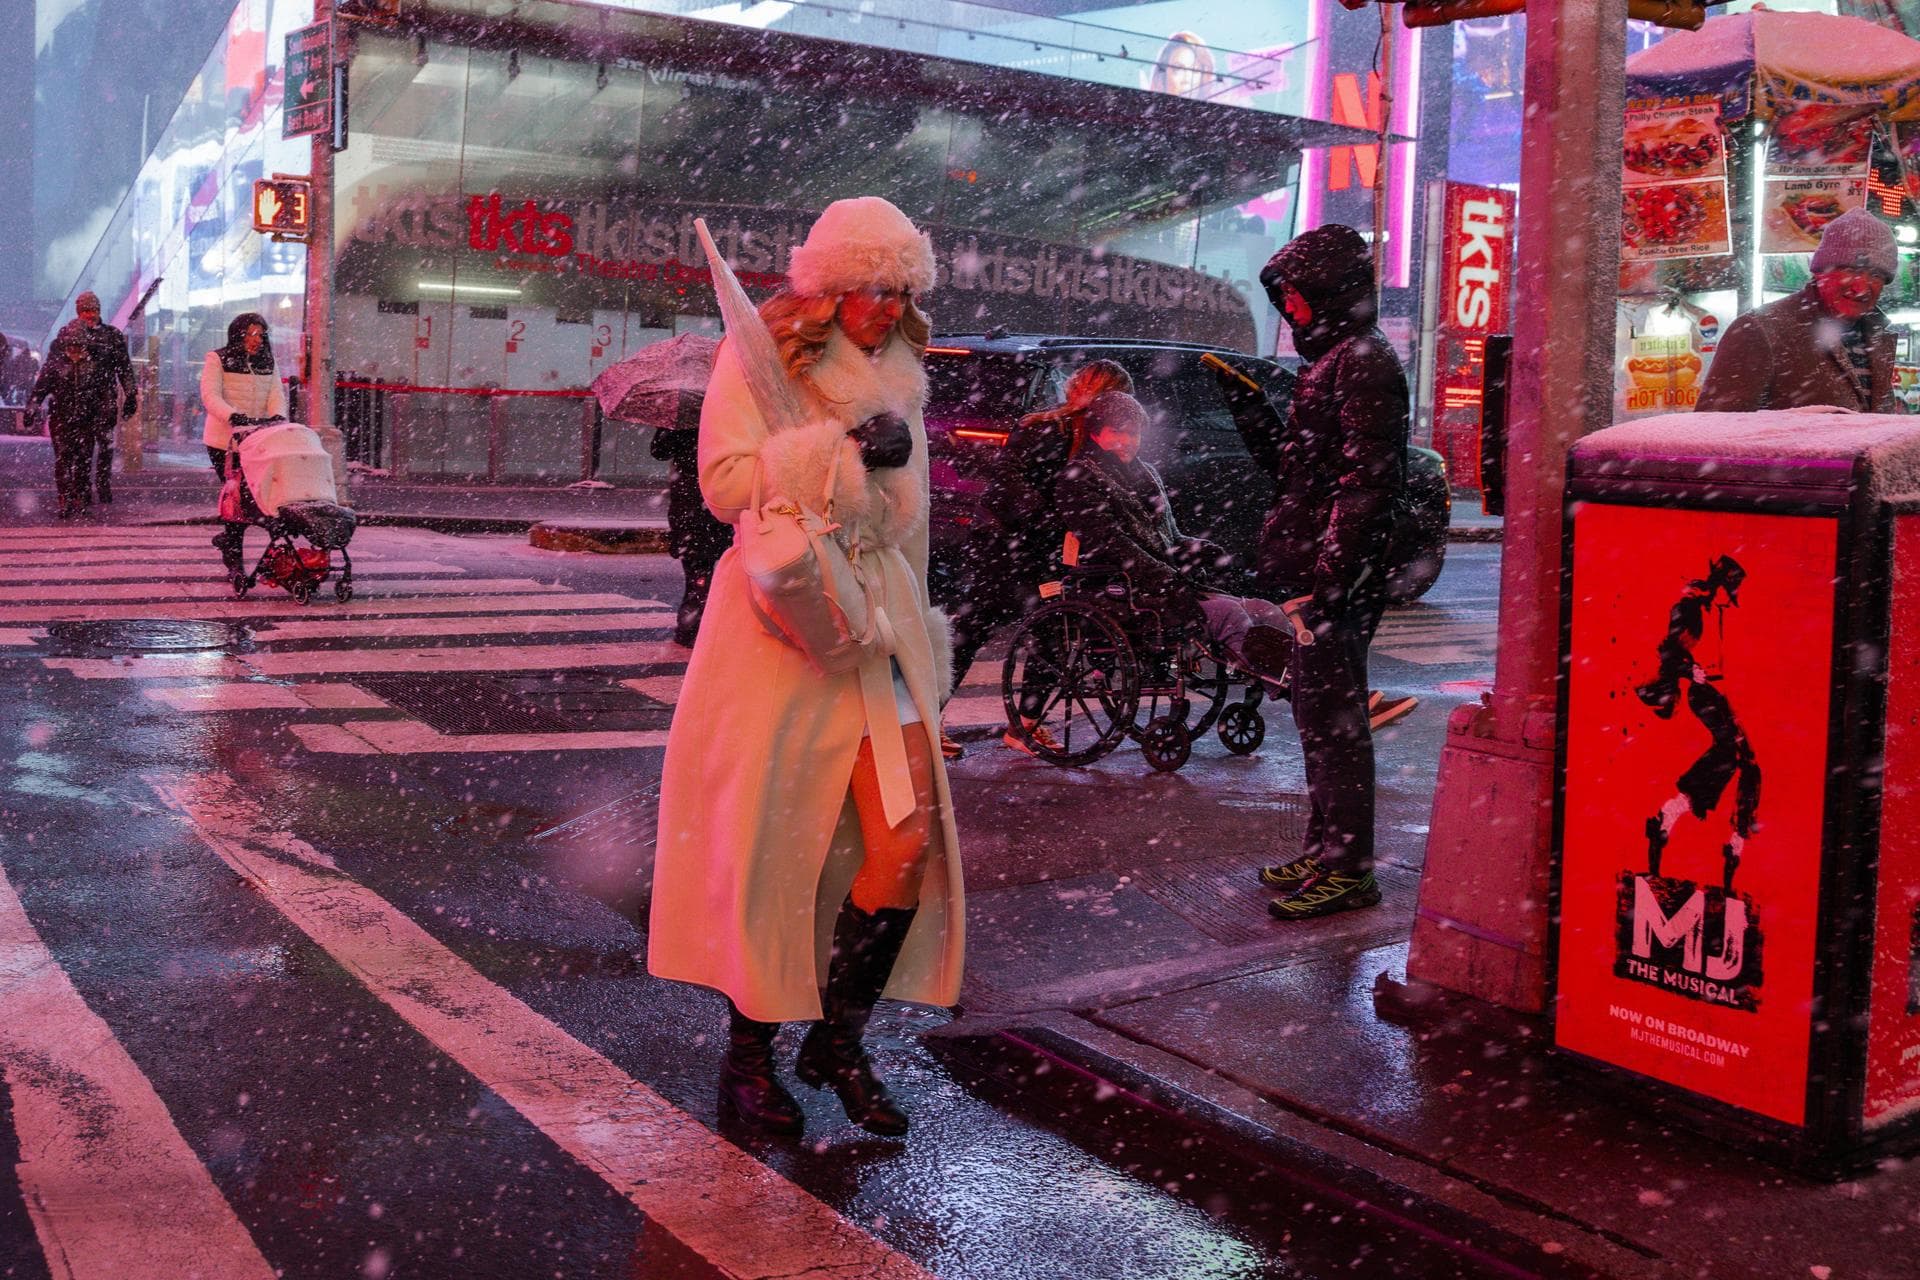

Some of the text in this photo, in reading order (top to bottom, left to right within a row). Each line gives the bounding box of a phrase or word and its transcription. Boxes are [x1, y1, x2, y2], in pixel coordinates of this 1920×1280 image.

[1630, 112, 1651, 122] Philly
[1688, 105, 1715, 116] Steak
[1784, 181, 1812, 190] Lamb
[294, 193, 305, 223] 3
[465, 193, 573, 257] tkts
[1668, 245, 1688, 254] Over
[1691, 244, 1710, 252] Rice
[1457, 197, 1505, 327] tkts
[424, 316, 431, 337] 1
[511, 320, 525, 341] 2
[597, 325, 611, 346] 3
[1628, 390, 1657, 409] HOT
[1632, 876, 1749, 981] MJ
[1626, 958, 1740, 1005] THE MUSICAL
[1609, 1004, 1750, 1058] NOW ON BROADWAY
[1630, 1027, 1726, 1068] MJTHEMUSICAL.COM
